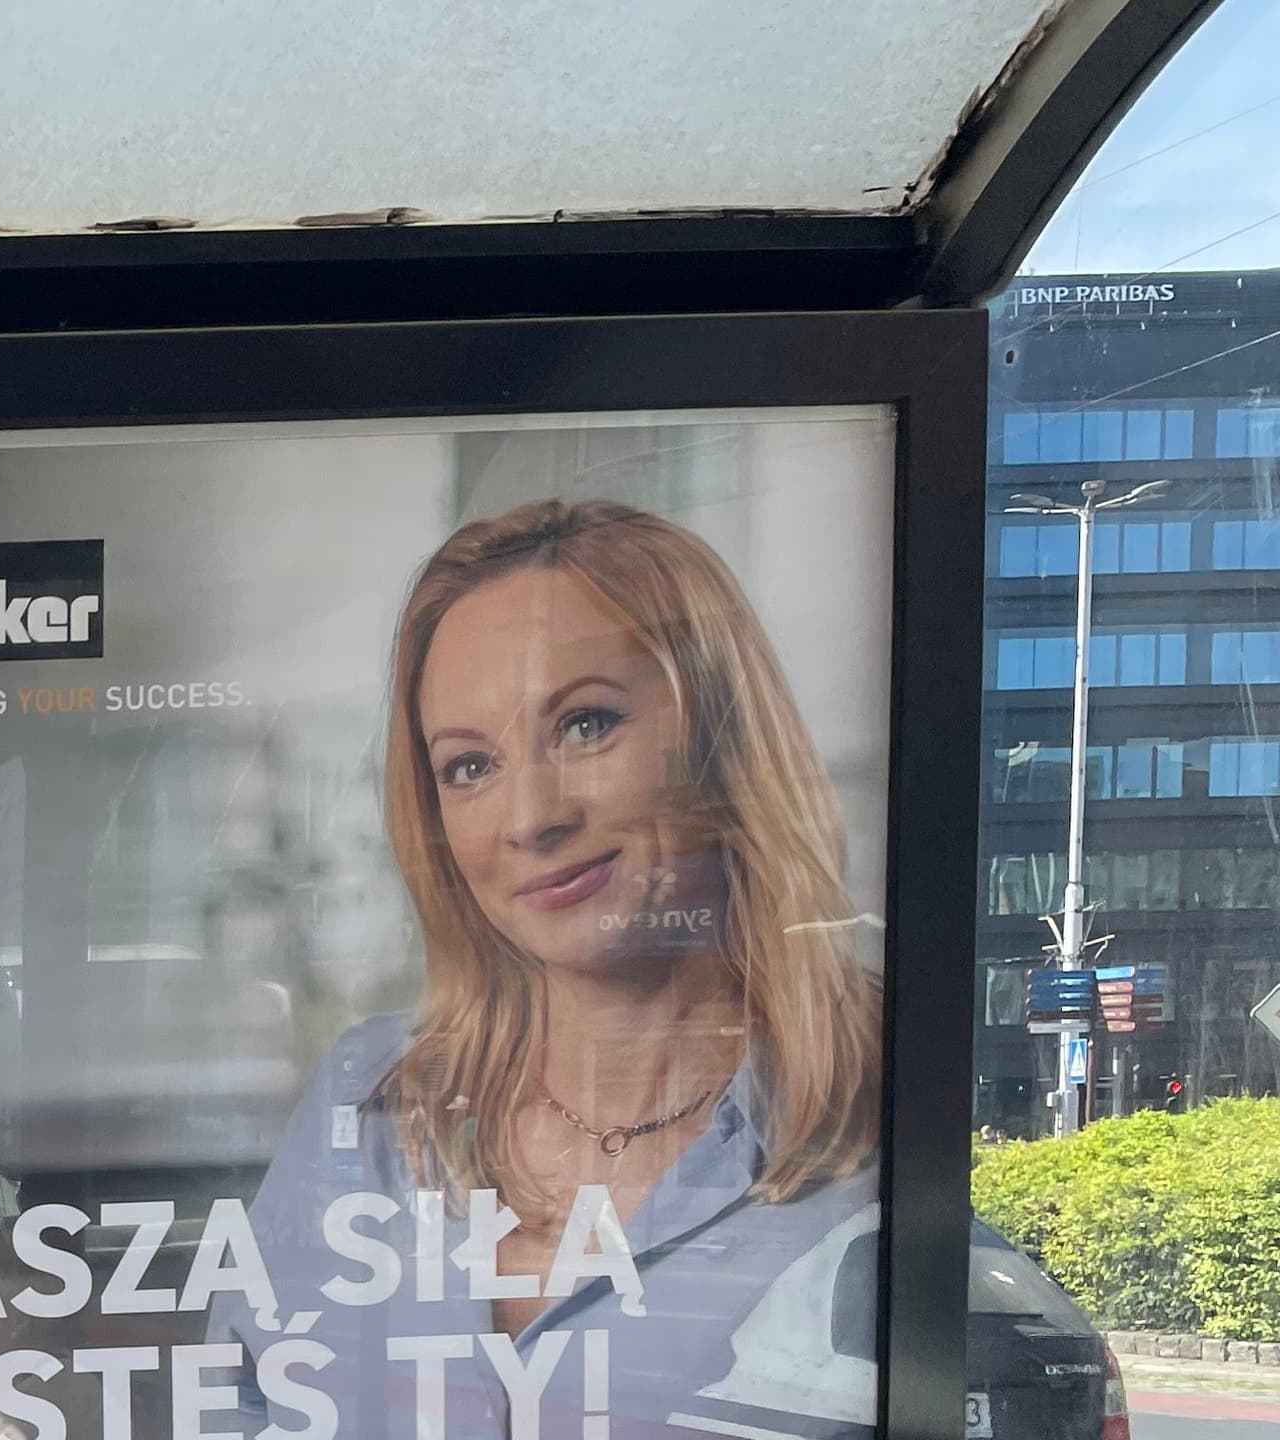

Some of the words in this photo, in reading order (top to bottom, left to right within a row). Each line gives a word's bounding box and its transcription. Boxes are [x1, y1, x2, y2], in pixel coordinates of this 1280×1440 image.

[1022, 287, 1069, 304] BNP
[1077, 284, 1175, 302] PARIBAS
[17, 687, 97, 715] YOUR
[320, 1184, 647, 1317] SIŁĄ
